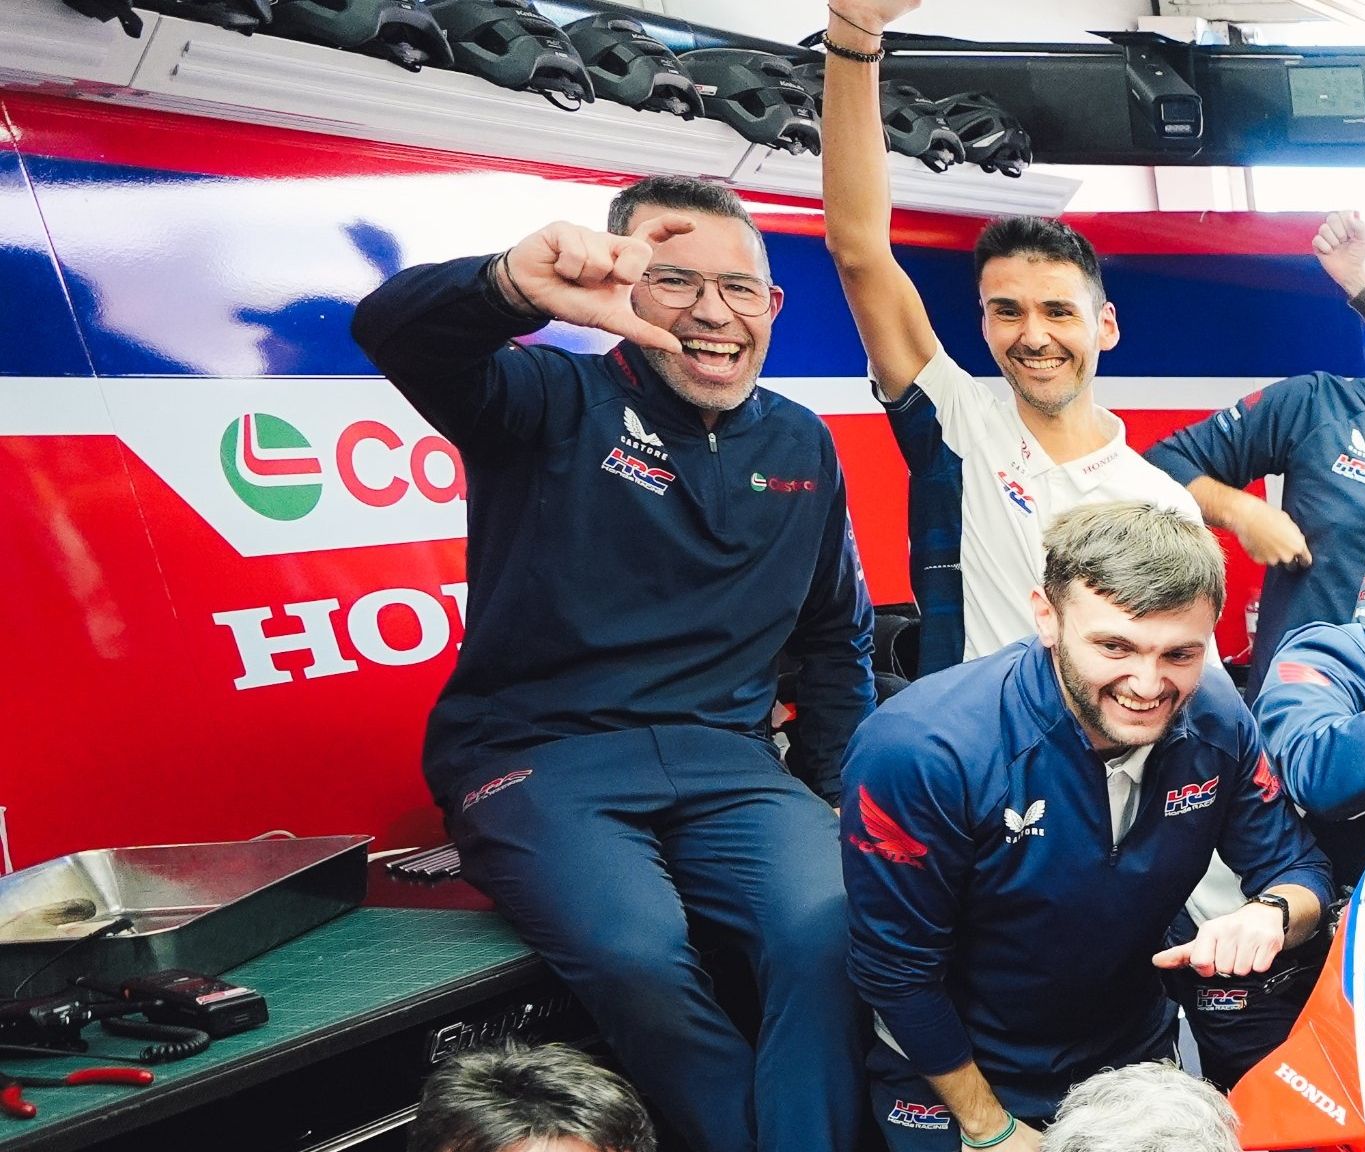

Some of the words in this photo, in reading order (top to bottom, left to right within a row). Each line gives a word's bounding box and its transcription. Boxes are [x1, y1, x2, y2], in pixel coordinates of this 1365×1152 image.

[620, 435, 669, 462] CASTORE
[1082, 451, 1119, 475] HONDA
[601, 447, 676, 489] HRC
[1165, 774, 1220, 813] HRC
[1273, 1063, 1350, 1127] HONDA
[888, 1099, 951, 1128] HRC
